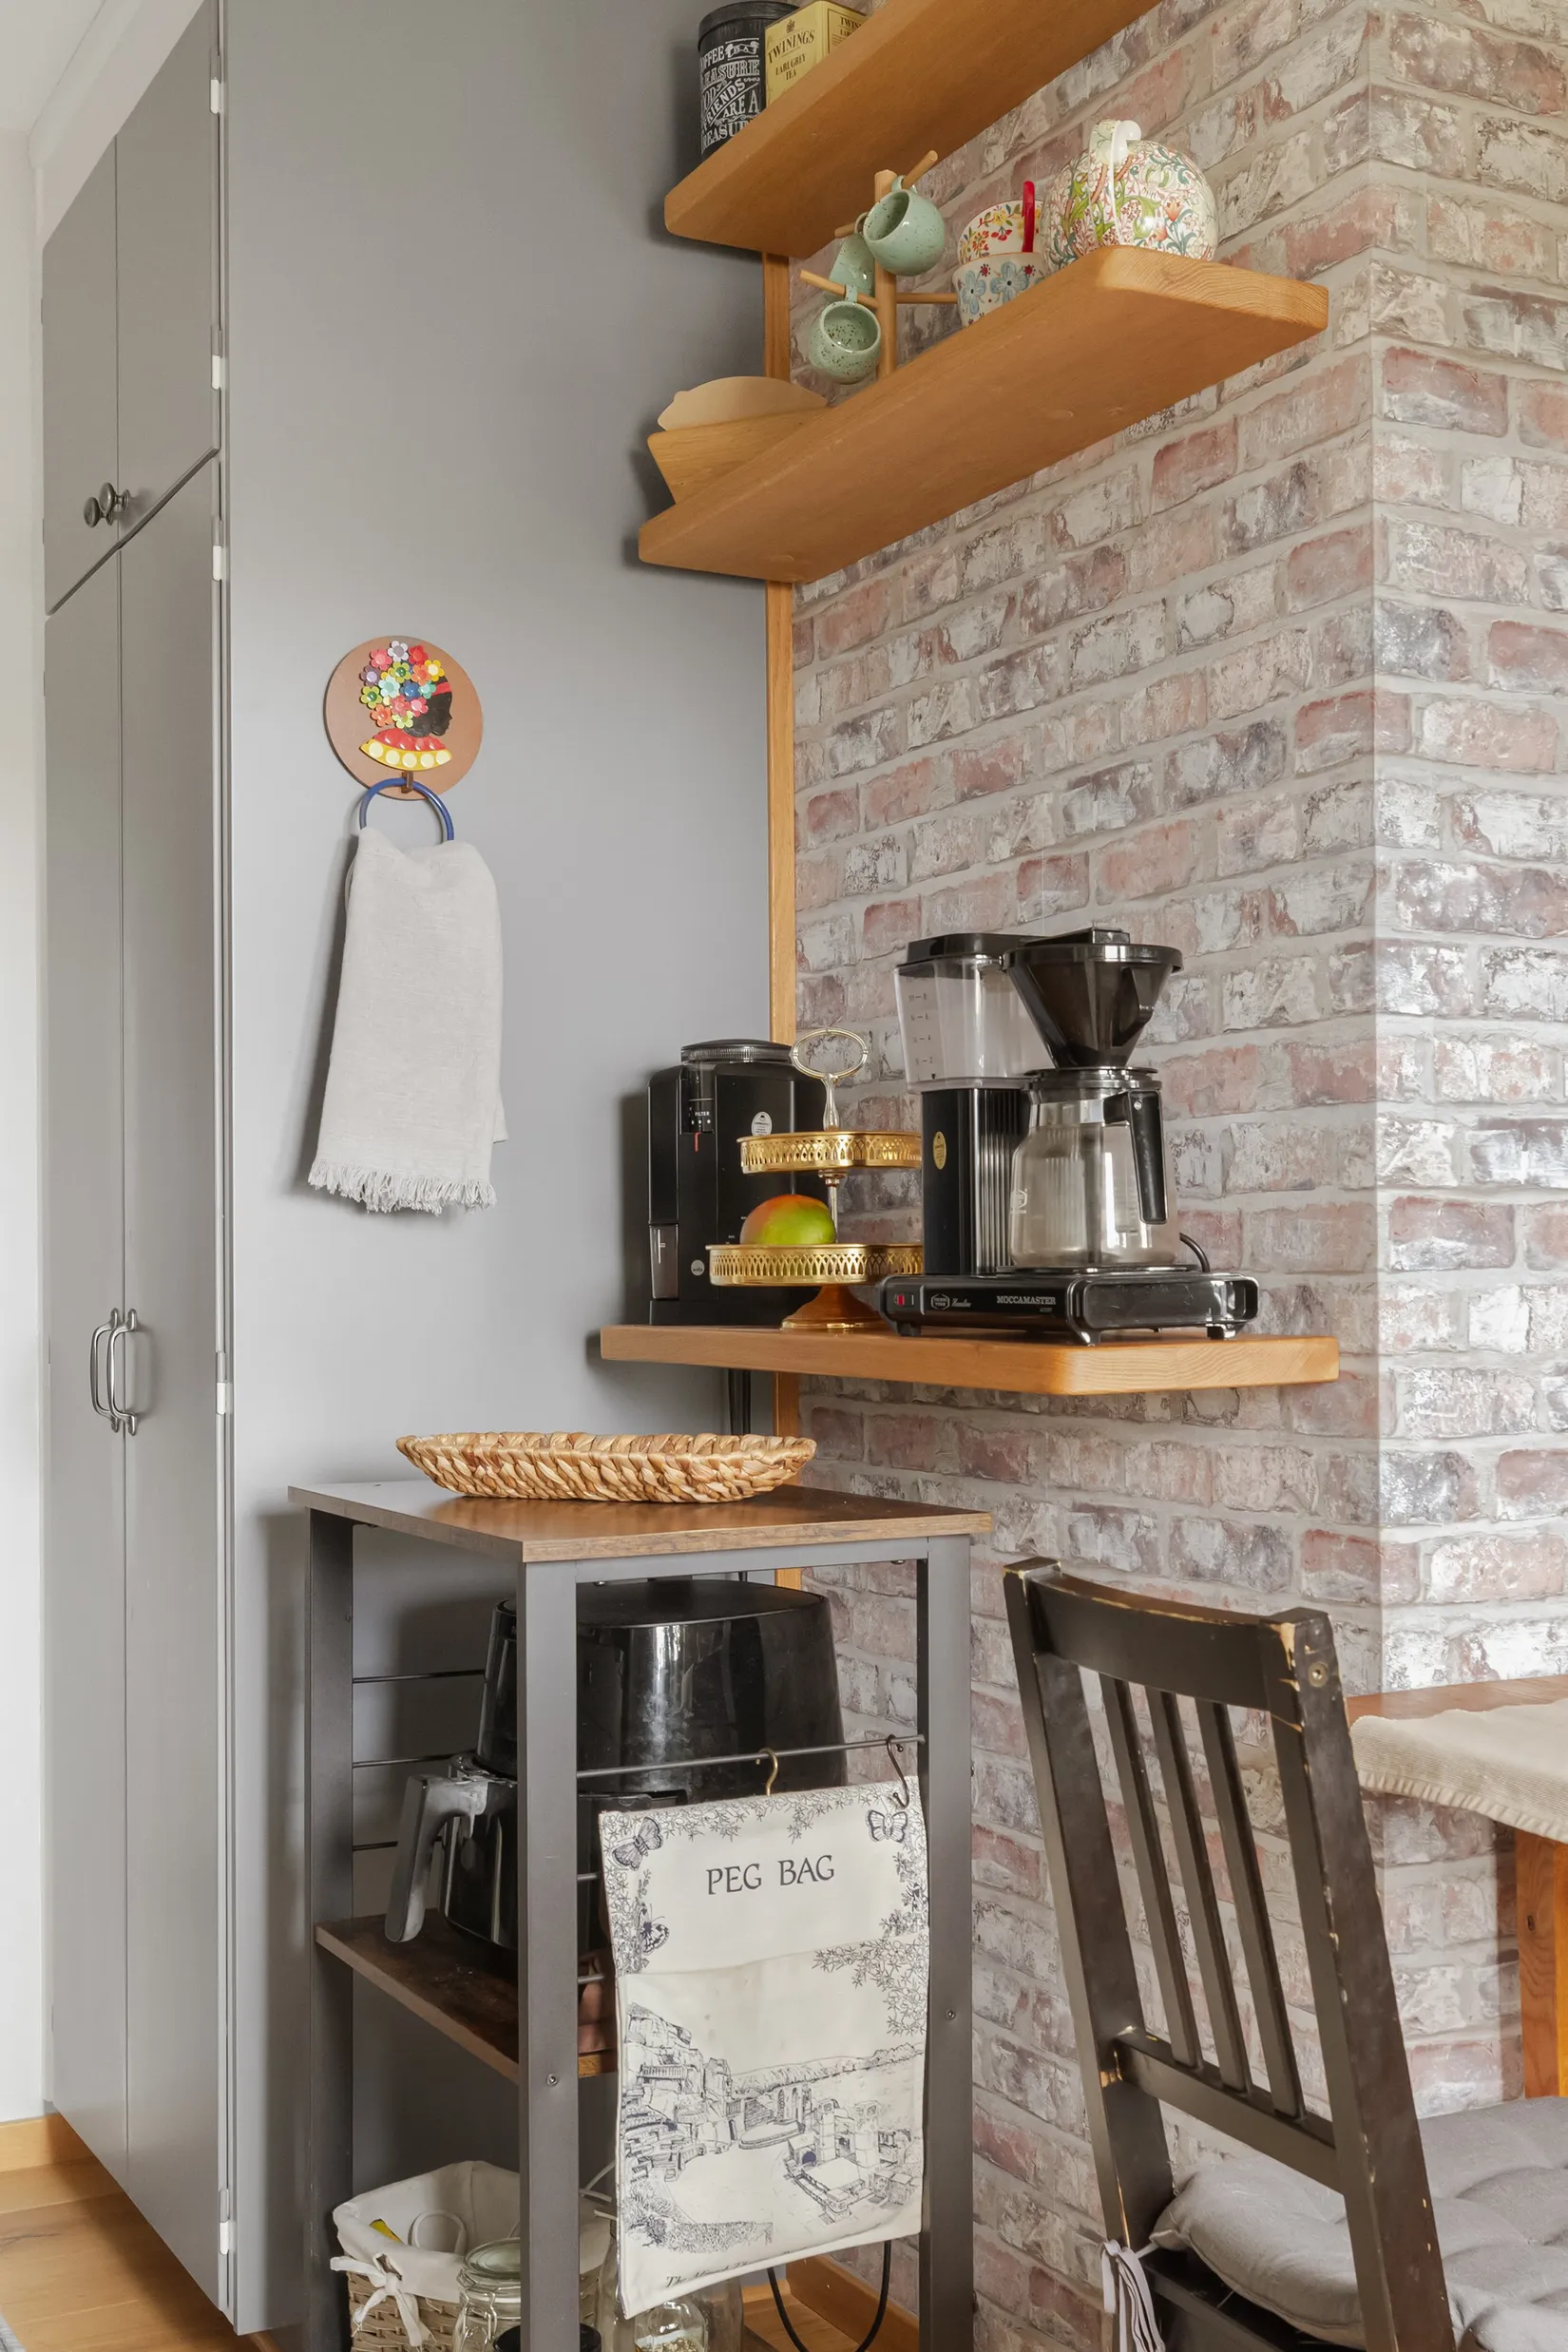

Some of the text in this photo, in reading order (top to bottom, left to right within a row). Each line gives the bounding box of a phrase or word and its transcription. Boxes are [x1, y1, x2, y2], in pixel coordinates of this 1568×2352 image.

[767, 30, 815, 64] TWININGS
[775, 54, 806, 75] EARL GREY
[786, 69, 797, 80] TEA
[723, 89, 760, 119] ARE A
[996, 1295, 1056, 1305] MOCCAMASTER
[706, 1855, 834, 1895] PEG BAG
